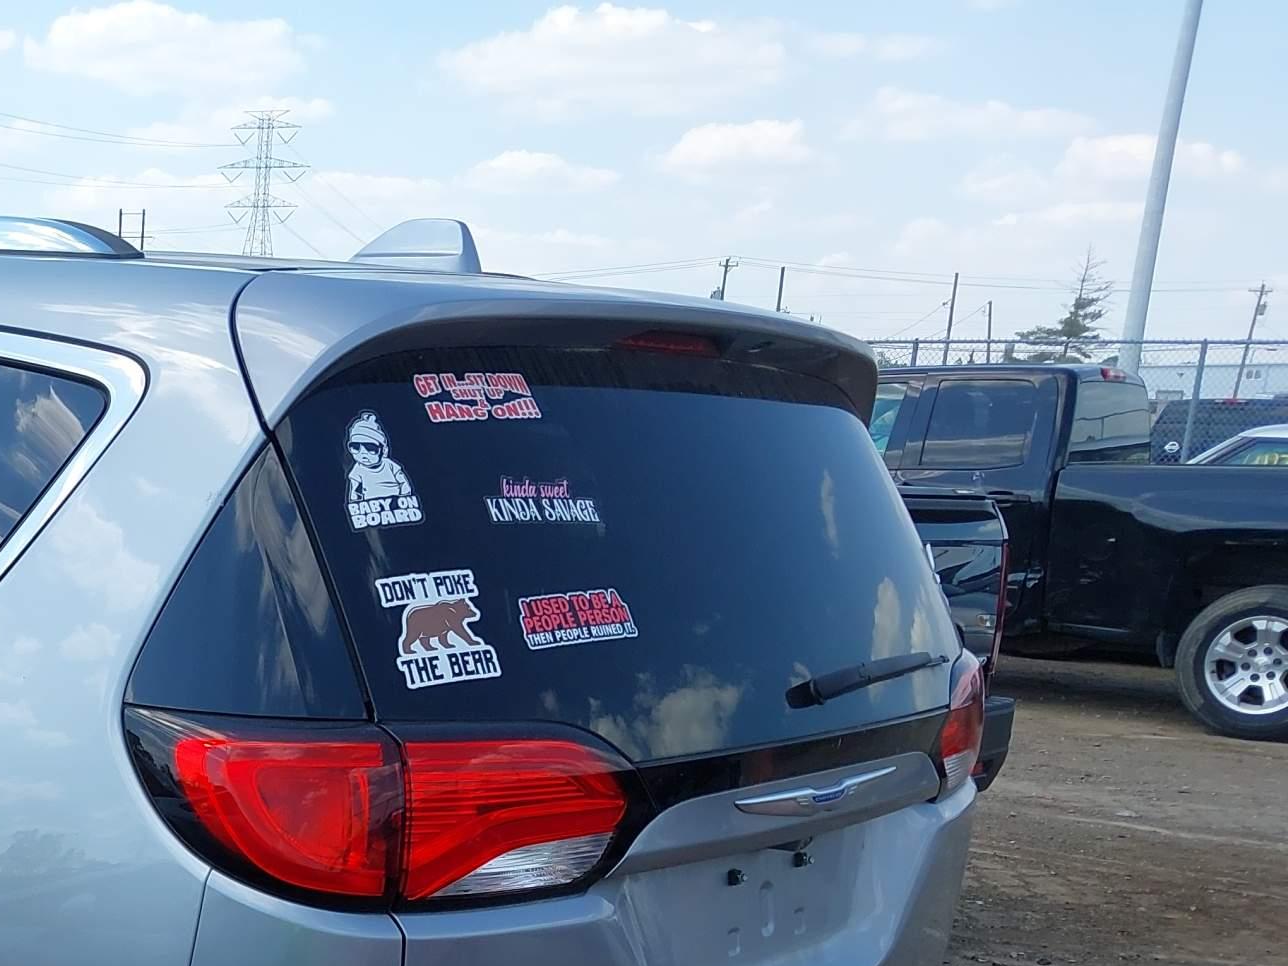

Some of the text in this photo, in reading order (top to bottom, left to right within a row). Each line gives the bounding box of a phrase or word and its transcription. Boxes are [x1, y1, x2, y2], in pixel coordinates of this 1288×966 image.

[414, 375, 442, 397] GET
[486, 374, 531, 396] DOWN
[452, 388, 504, 399] SHUT UP
[425, 398, 541, 421] HANG ON!!!
[478, 399, 490, 409] &
[503, 479, 569, 498] kinda sweet
[348, 496, 419, 515] BABY ON
[487, 498, 600, 522] KINDA SAVAGE
[352, 508, 422, 529] BOARD
[380, 574, 474, 602] DON'T POKE
[523, 591, 622, 617] I USED TO BE A
[524, 606, 629, 633] PEOPLE PERSON
[528, 632, 554, 645] THEN
[554, 626, 590, 642] PEOPLE
[591, 622, 623, 636] RUINED
[401, 649, 497, 685] THE BEAR
